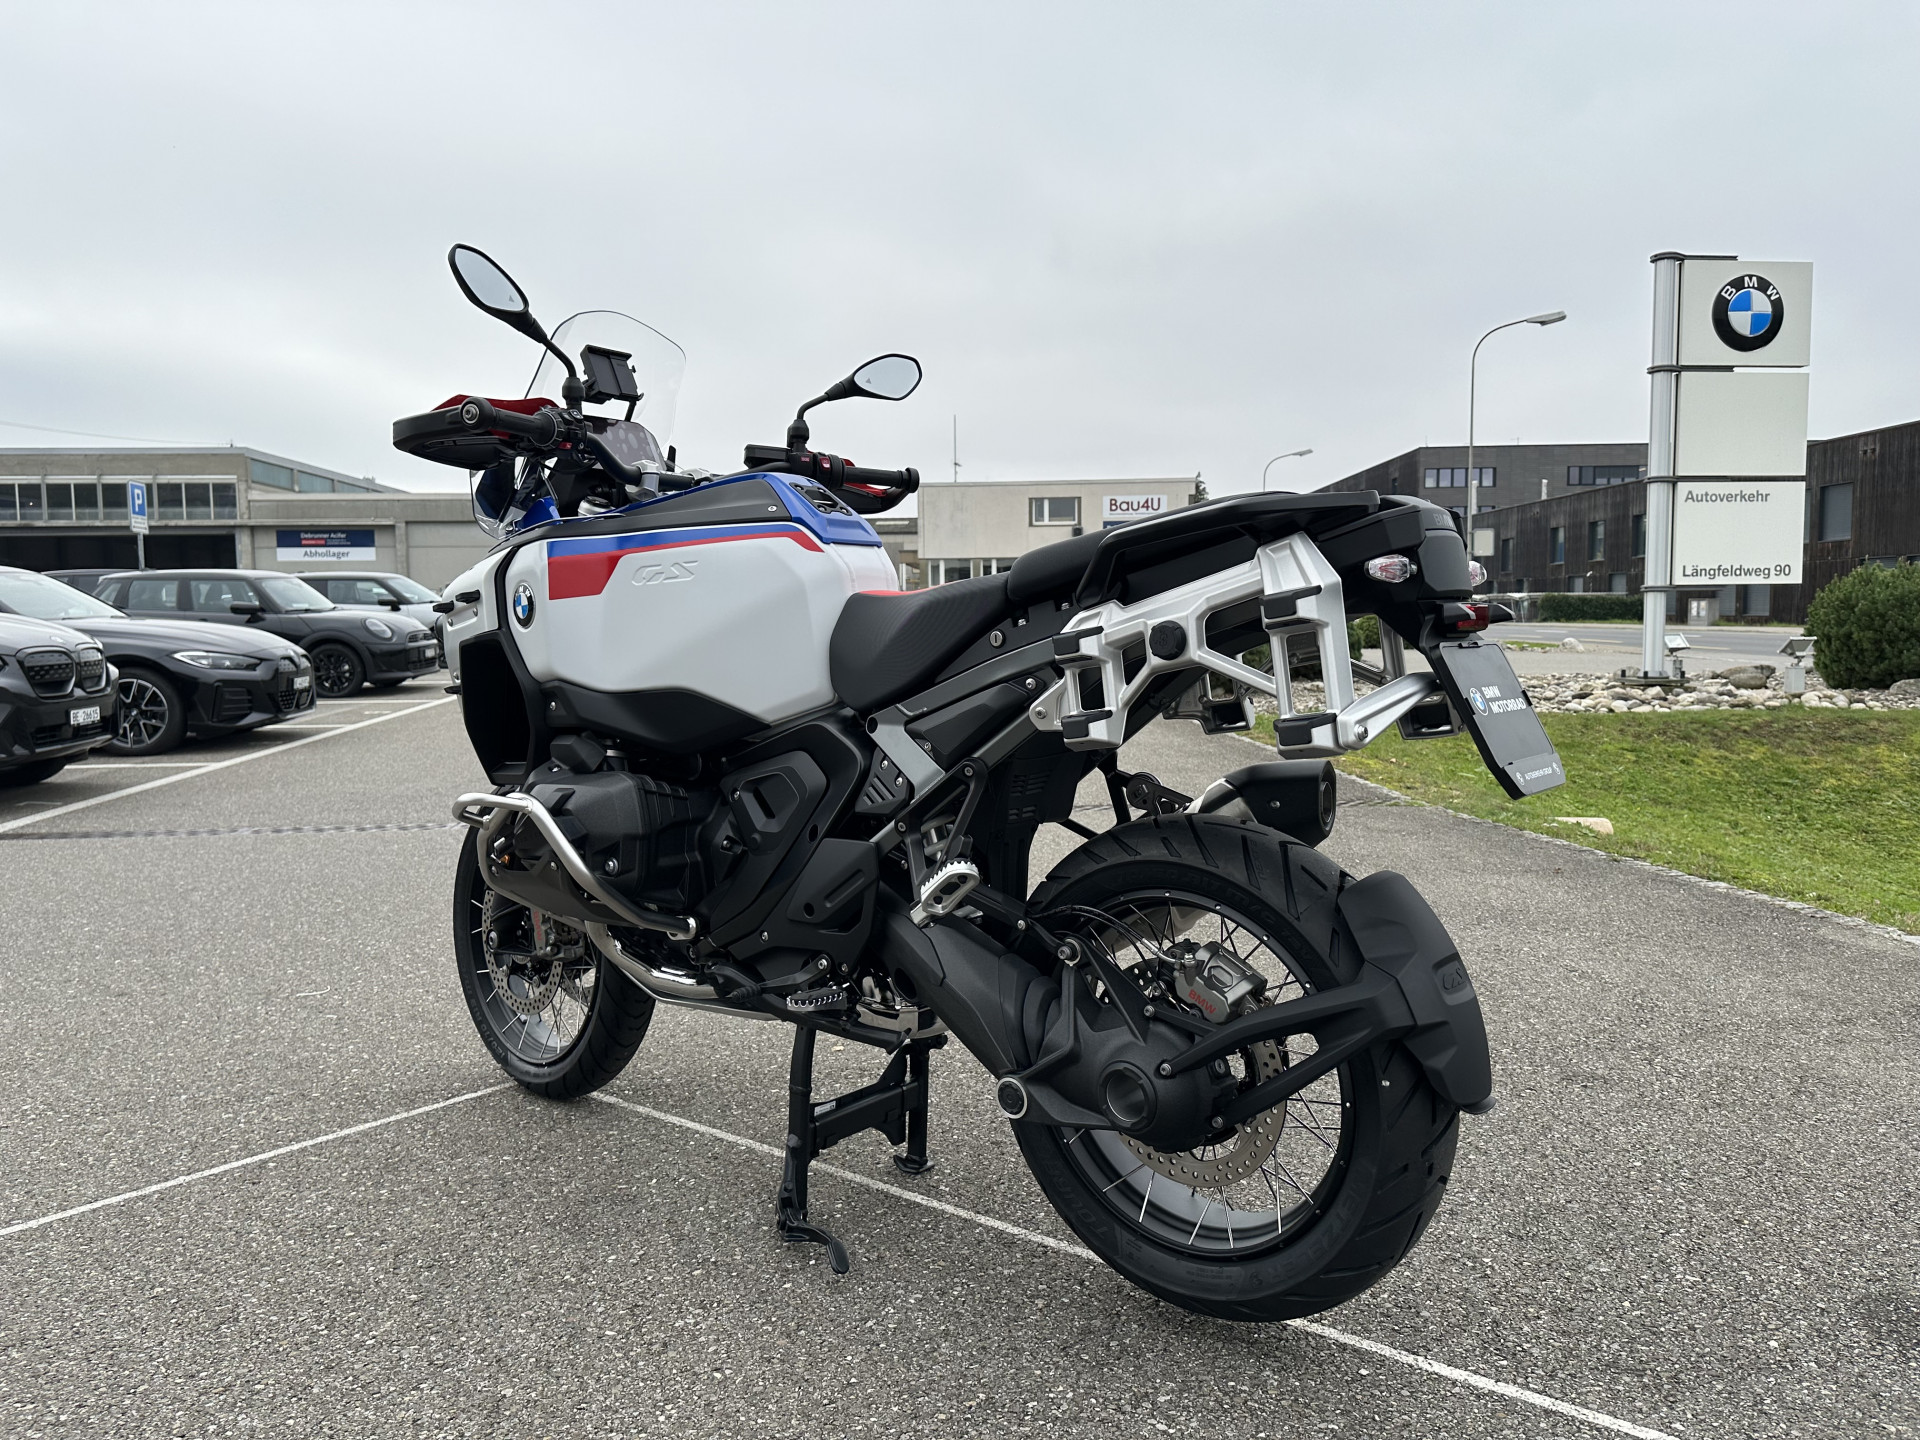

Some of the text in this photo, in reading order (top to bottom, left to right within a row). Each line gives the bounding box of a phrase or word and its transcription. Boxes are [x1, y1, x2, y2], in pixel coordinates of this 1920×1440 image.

[1721, 276, 1780, 300] BMW
[134, 488, 143, 512] P
[1109, 497, 1161, 512] Bau4U
[1684, 490, 1770, 503] Autoverkehr
[303, 550, 350, 559] Abhollager
[1682, 564, 1792, 580] Längfeldweg 90
[1481, 685, 1501, 699] BMW
[1489, 697, 1527, 714] MOTORRAD
[1188, 989, 1217, 1014] BMW
